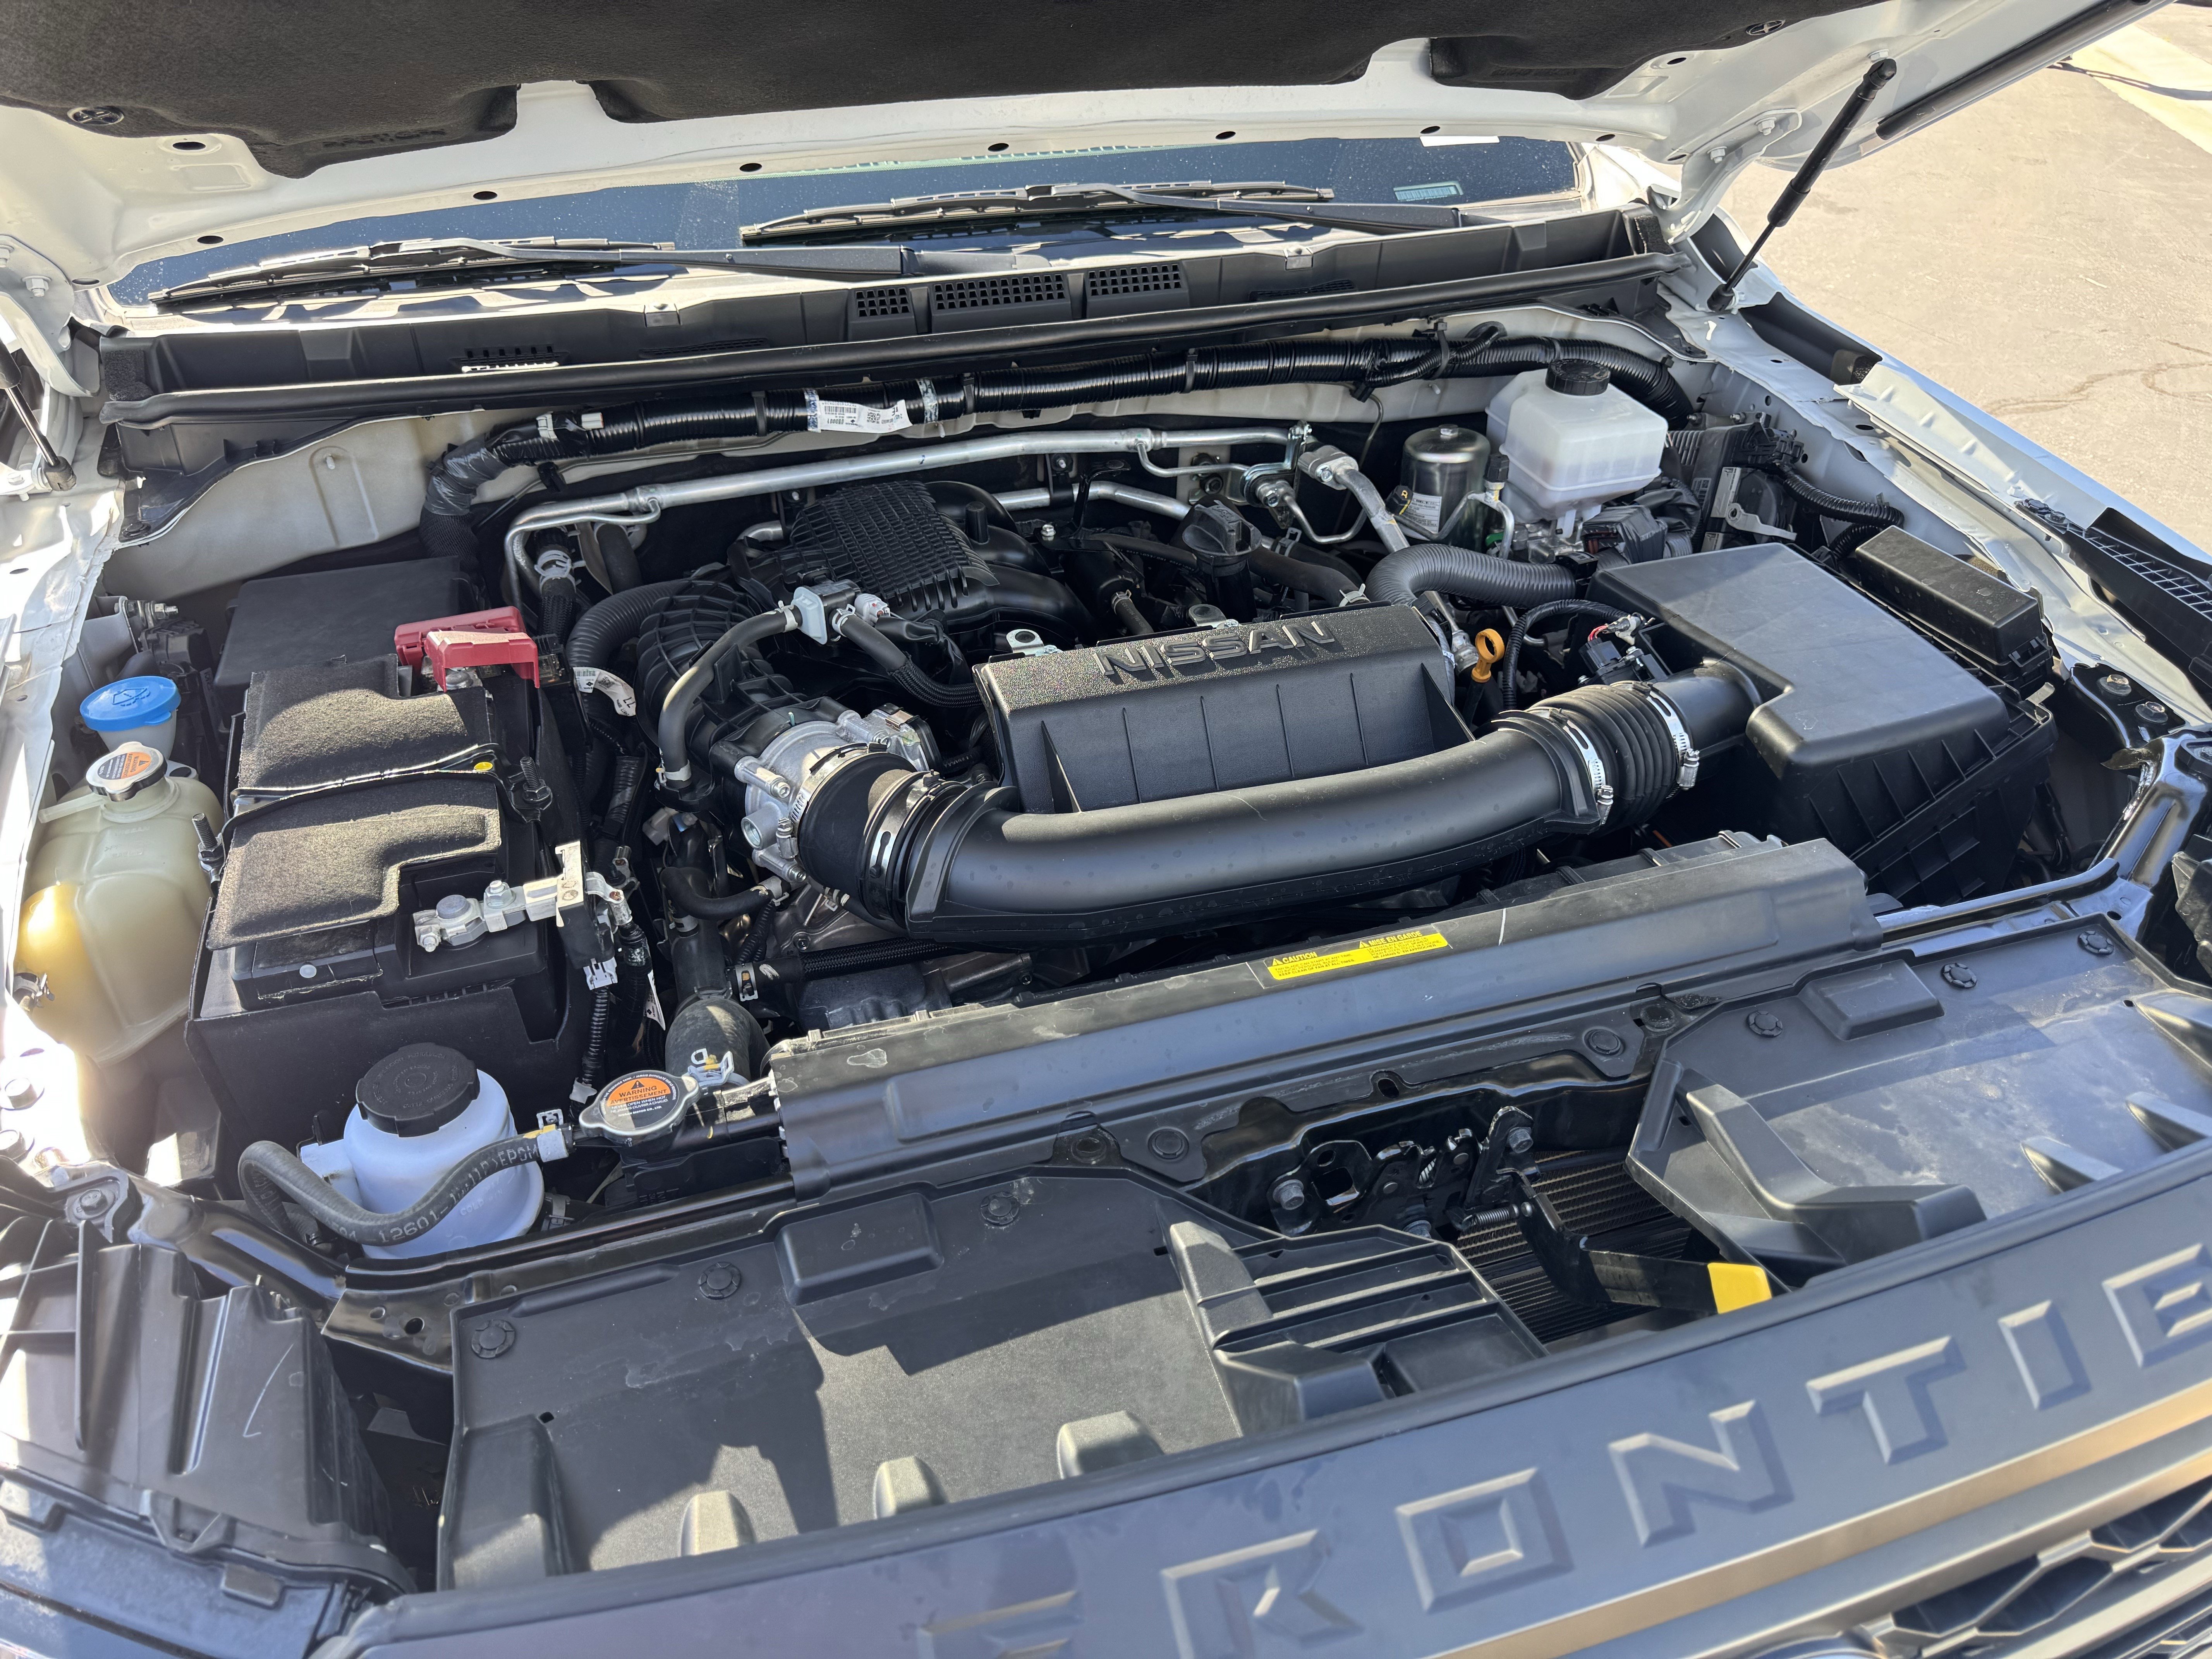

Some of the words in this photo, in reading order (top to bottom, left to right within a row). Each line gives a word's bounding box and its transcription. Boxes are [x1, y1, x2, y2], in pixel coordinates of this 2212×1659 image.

[1092, 621, 1335, 676] NISSAN
[1397, 931, 1423, 940] GARDE
[1282, 951, 1318, 963] CAUTION
[610, 1089, 667, 1104] AVERTISSEMENT
[619, 1085, 657, 1097] WARNING
